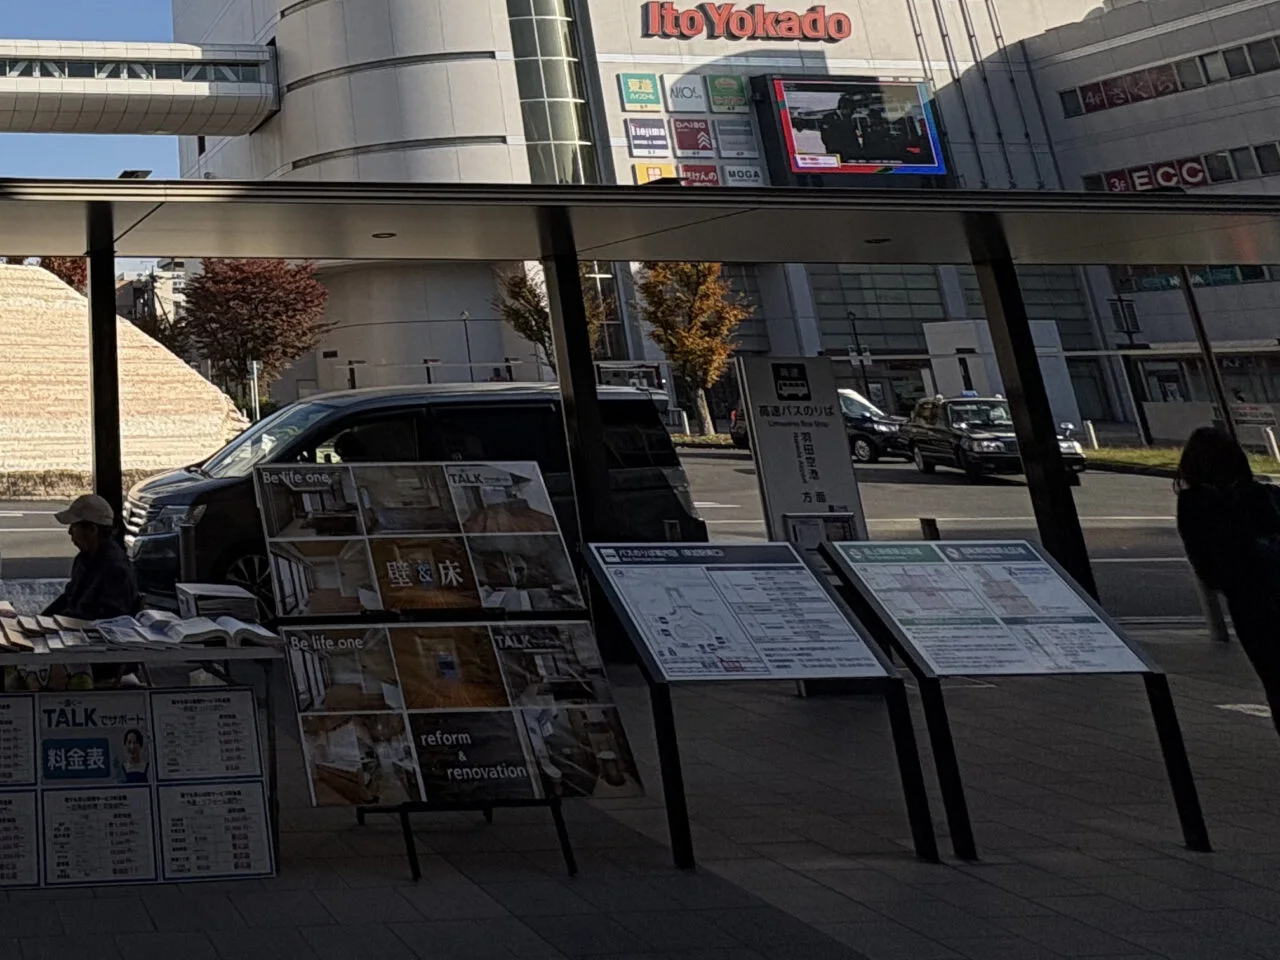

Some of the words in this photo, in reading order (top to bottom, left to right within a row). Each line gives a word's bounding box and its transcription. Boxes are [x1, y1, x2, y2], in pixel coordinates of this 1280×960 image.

[675, 121, 706, 129] DAISO
[728, 170, 761, 178] MOGA
[1132, 161, 1204, 191] ECC
[758, 404, 835, 417] 高速バスのりば
[262, 471, 279, 484] Be
[448, 473, 483, 484] TALK
[290, 635, 310, 650] Be
[312, 635, 336, 650] life
[337, 638, 365, 650] one
[494, 634, 532, 648] TALK
[42, 707, 98, 728] TALK
[99, 713, 145, 726] でサポート
[420, 731, 472, 746] reform
[47, 746, 106, 771] 料金表
[458, 749, 468, 762] &
[447, 764, 528, 781] renovation
